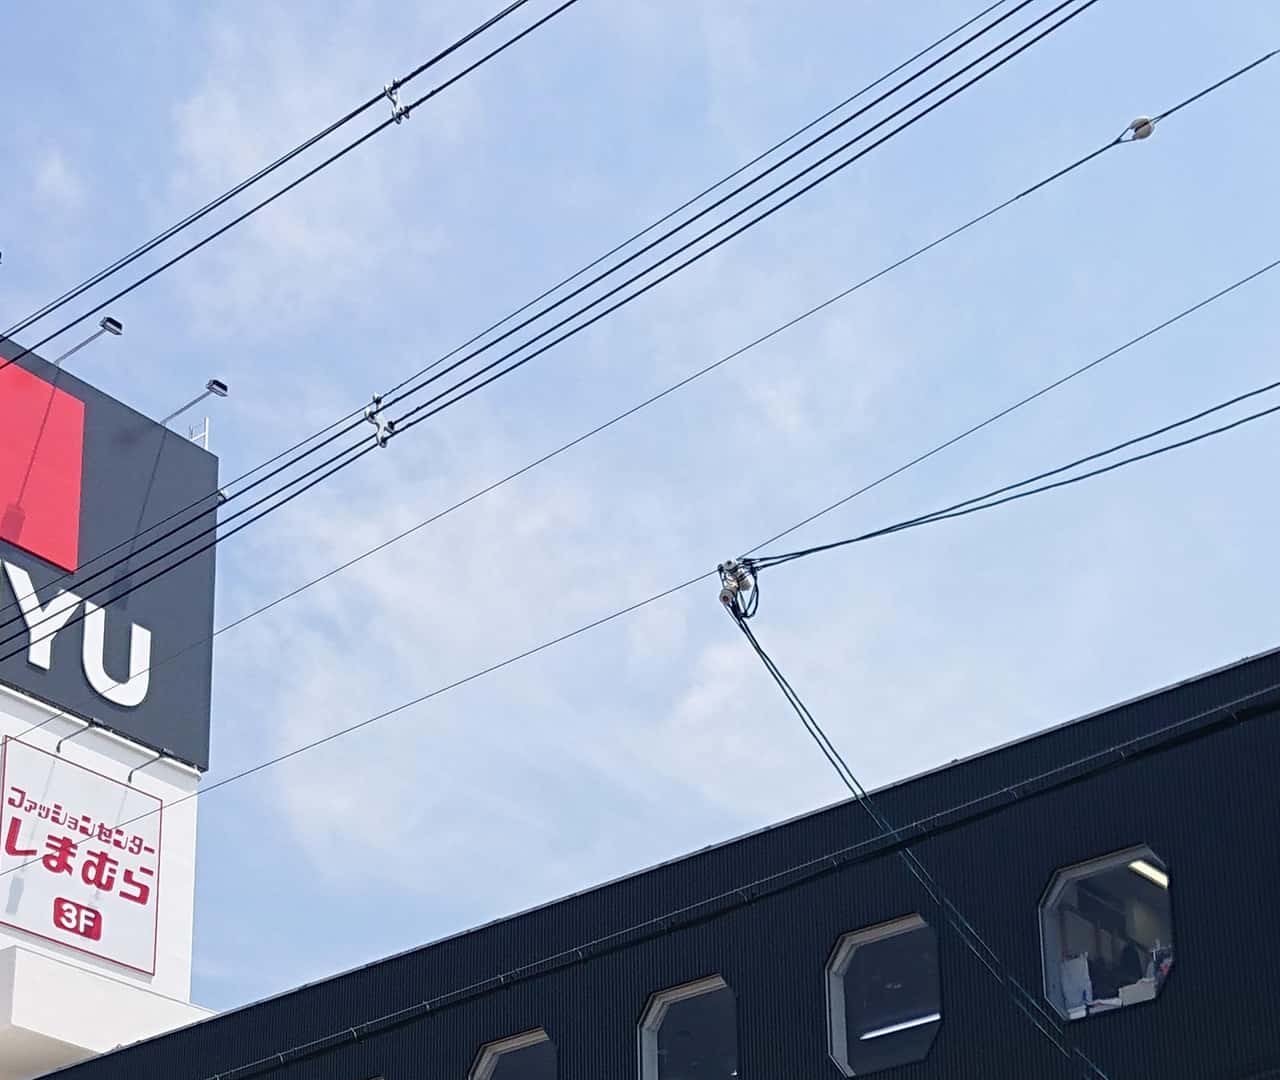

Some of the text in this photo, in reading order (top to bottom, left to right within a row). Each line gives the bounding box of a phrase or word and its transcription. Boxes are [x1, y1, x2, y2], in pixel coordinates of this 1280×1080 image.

[7, 786, 155, 855] ファッションセンター
[5, 816, 154, 905] しまむら
[60, 903, 96, 933] 3F
